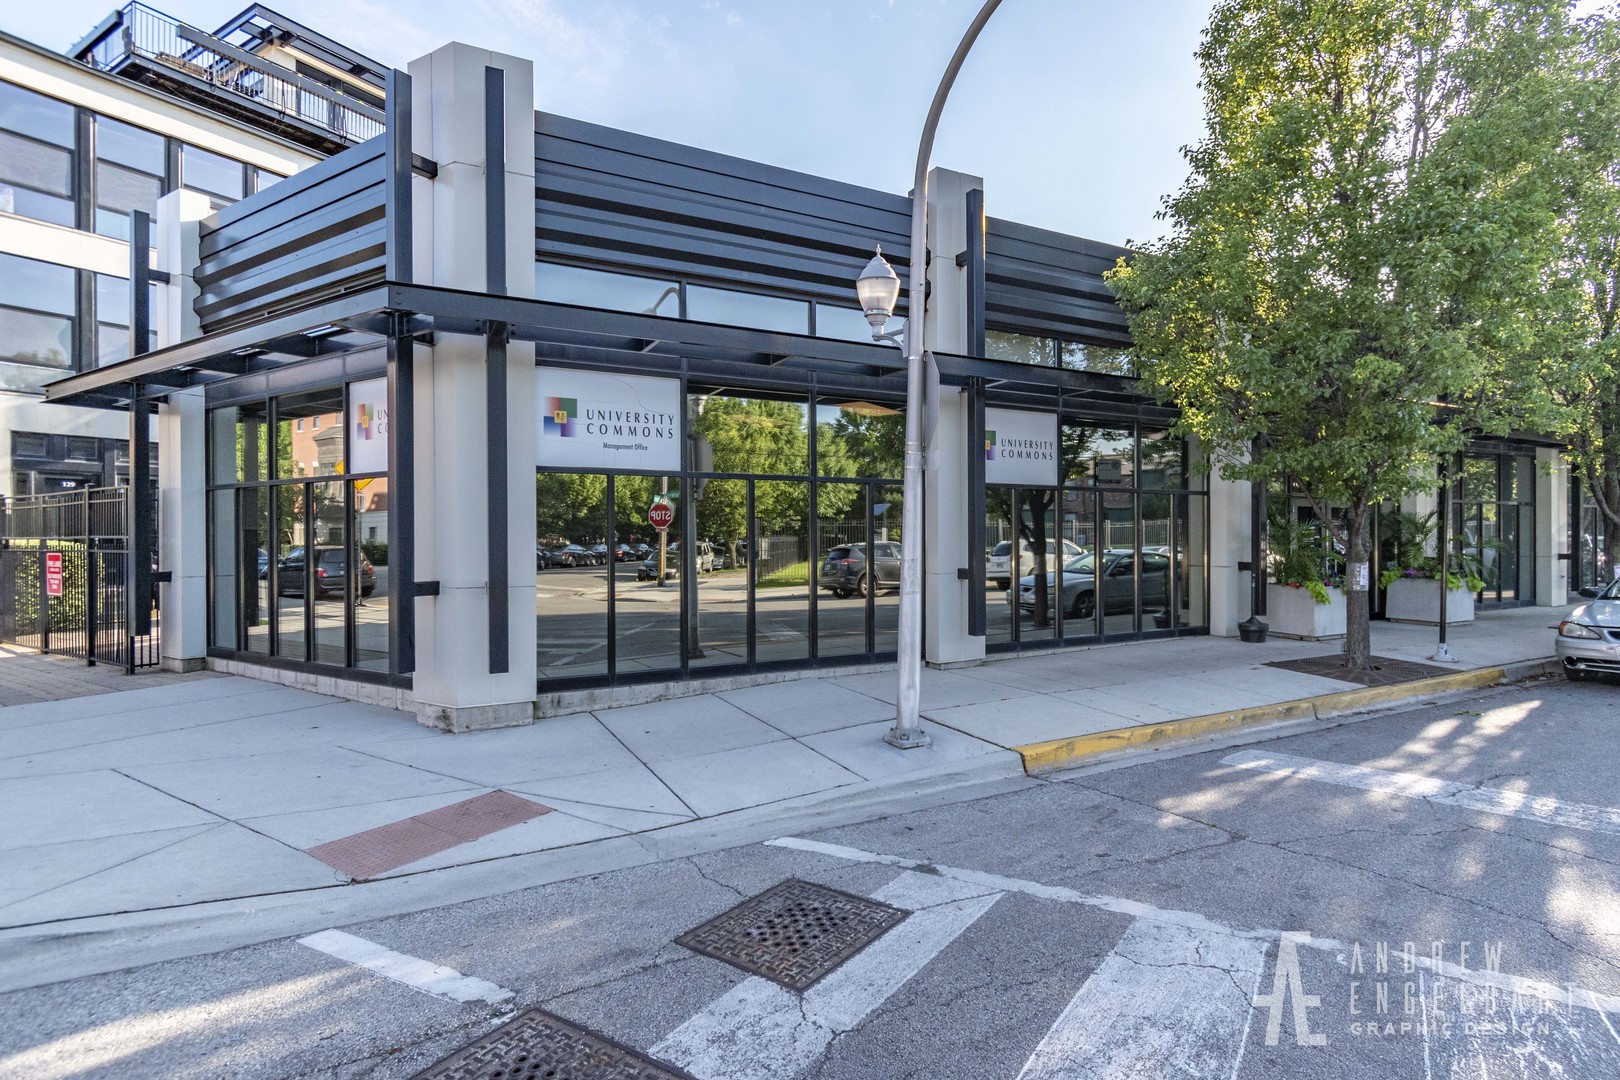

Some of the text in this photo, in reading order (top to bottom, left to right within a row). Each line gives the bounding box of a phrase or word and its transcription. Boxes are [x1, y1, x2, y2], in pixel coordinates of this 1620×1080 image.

[586, 408, 675, 426] UNIVERSITY
[586, 422, 674, 440] COMMONS
[602, 442, 648, 451] Management Office
[1001, 438, 1054, 450] UNIVERSITY
[1001, 449, 1054, 461] COMMONS
